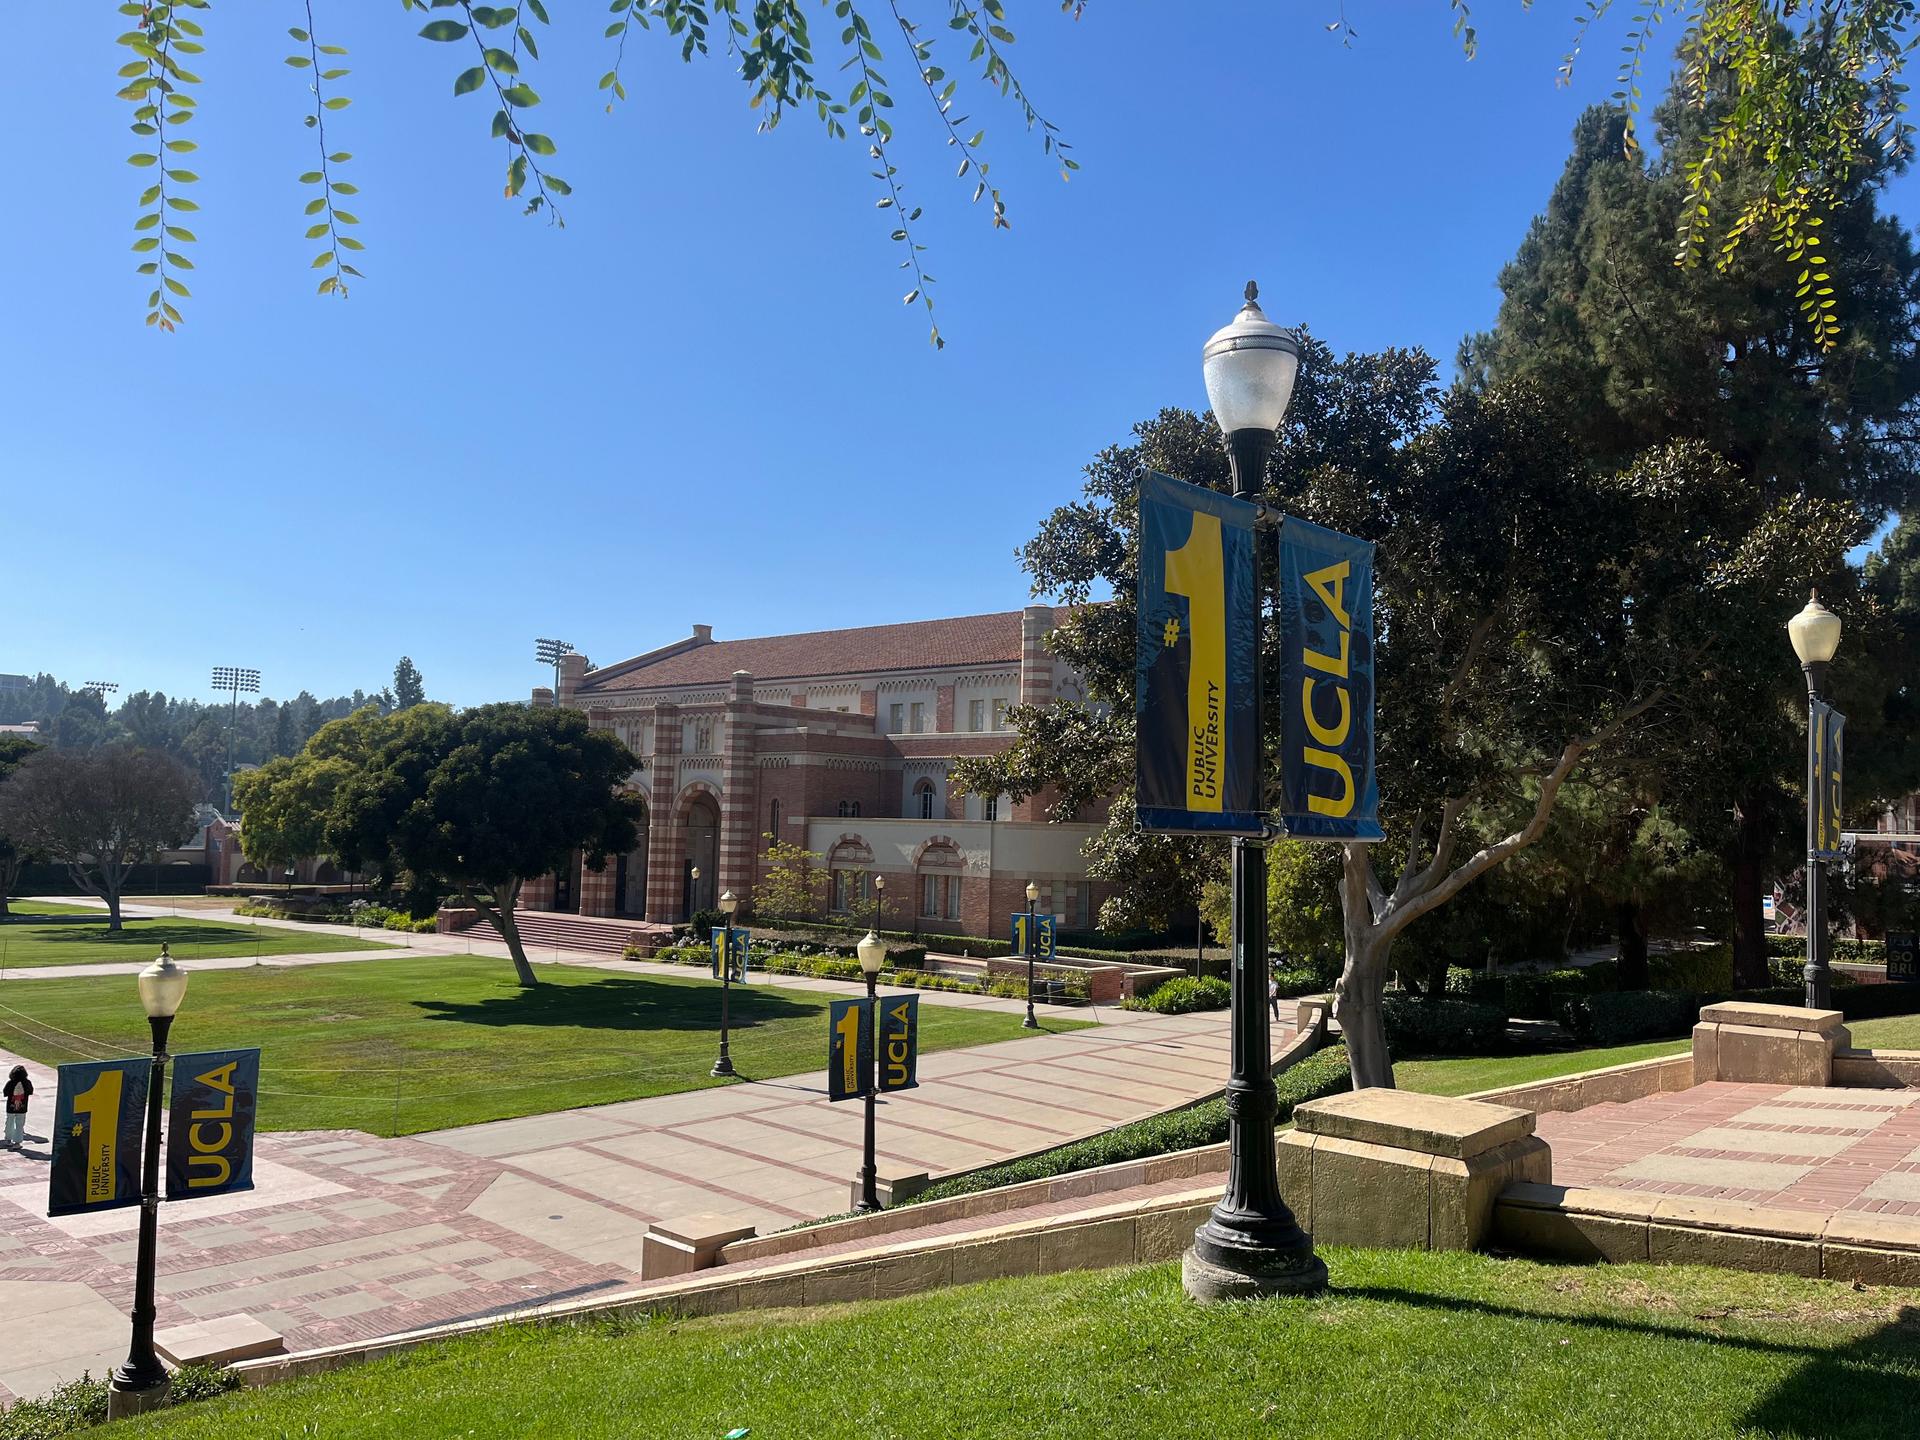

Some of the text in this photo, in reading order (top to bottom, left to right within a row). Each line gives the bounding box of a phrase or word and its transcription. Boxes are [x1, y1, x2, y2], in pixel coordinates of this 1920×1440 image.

[1165, 511, 1226, 813] #1
[1302, 560, 1356, 818] UCLA
[1193, 727, 1205, 796] PUBLIC
[1205, 680, 1221, 799] UNIVERSITY
[1039, 919, 1051, 956] UCLA
[1889, 950, 1913, 962] GO
[887, 1001, 910, 1085] UCLA
[71, 1069, 124, 1204] #1
[188, 1061, 237, 1188] UCLA
[91, 1166, 101, 1196] PUBLIC
[100, 1144, 110, 1195] UNIVERSITY
